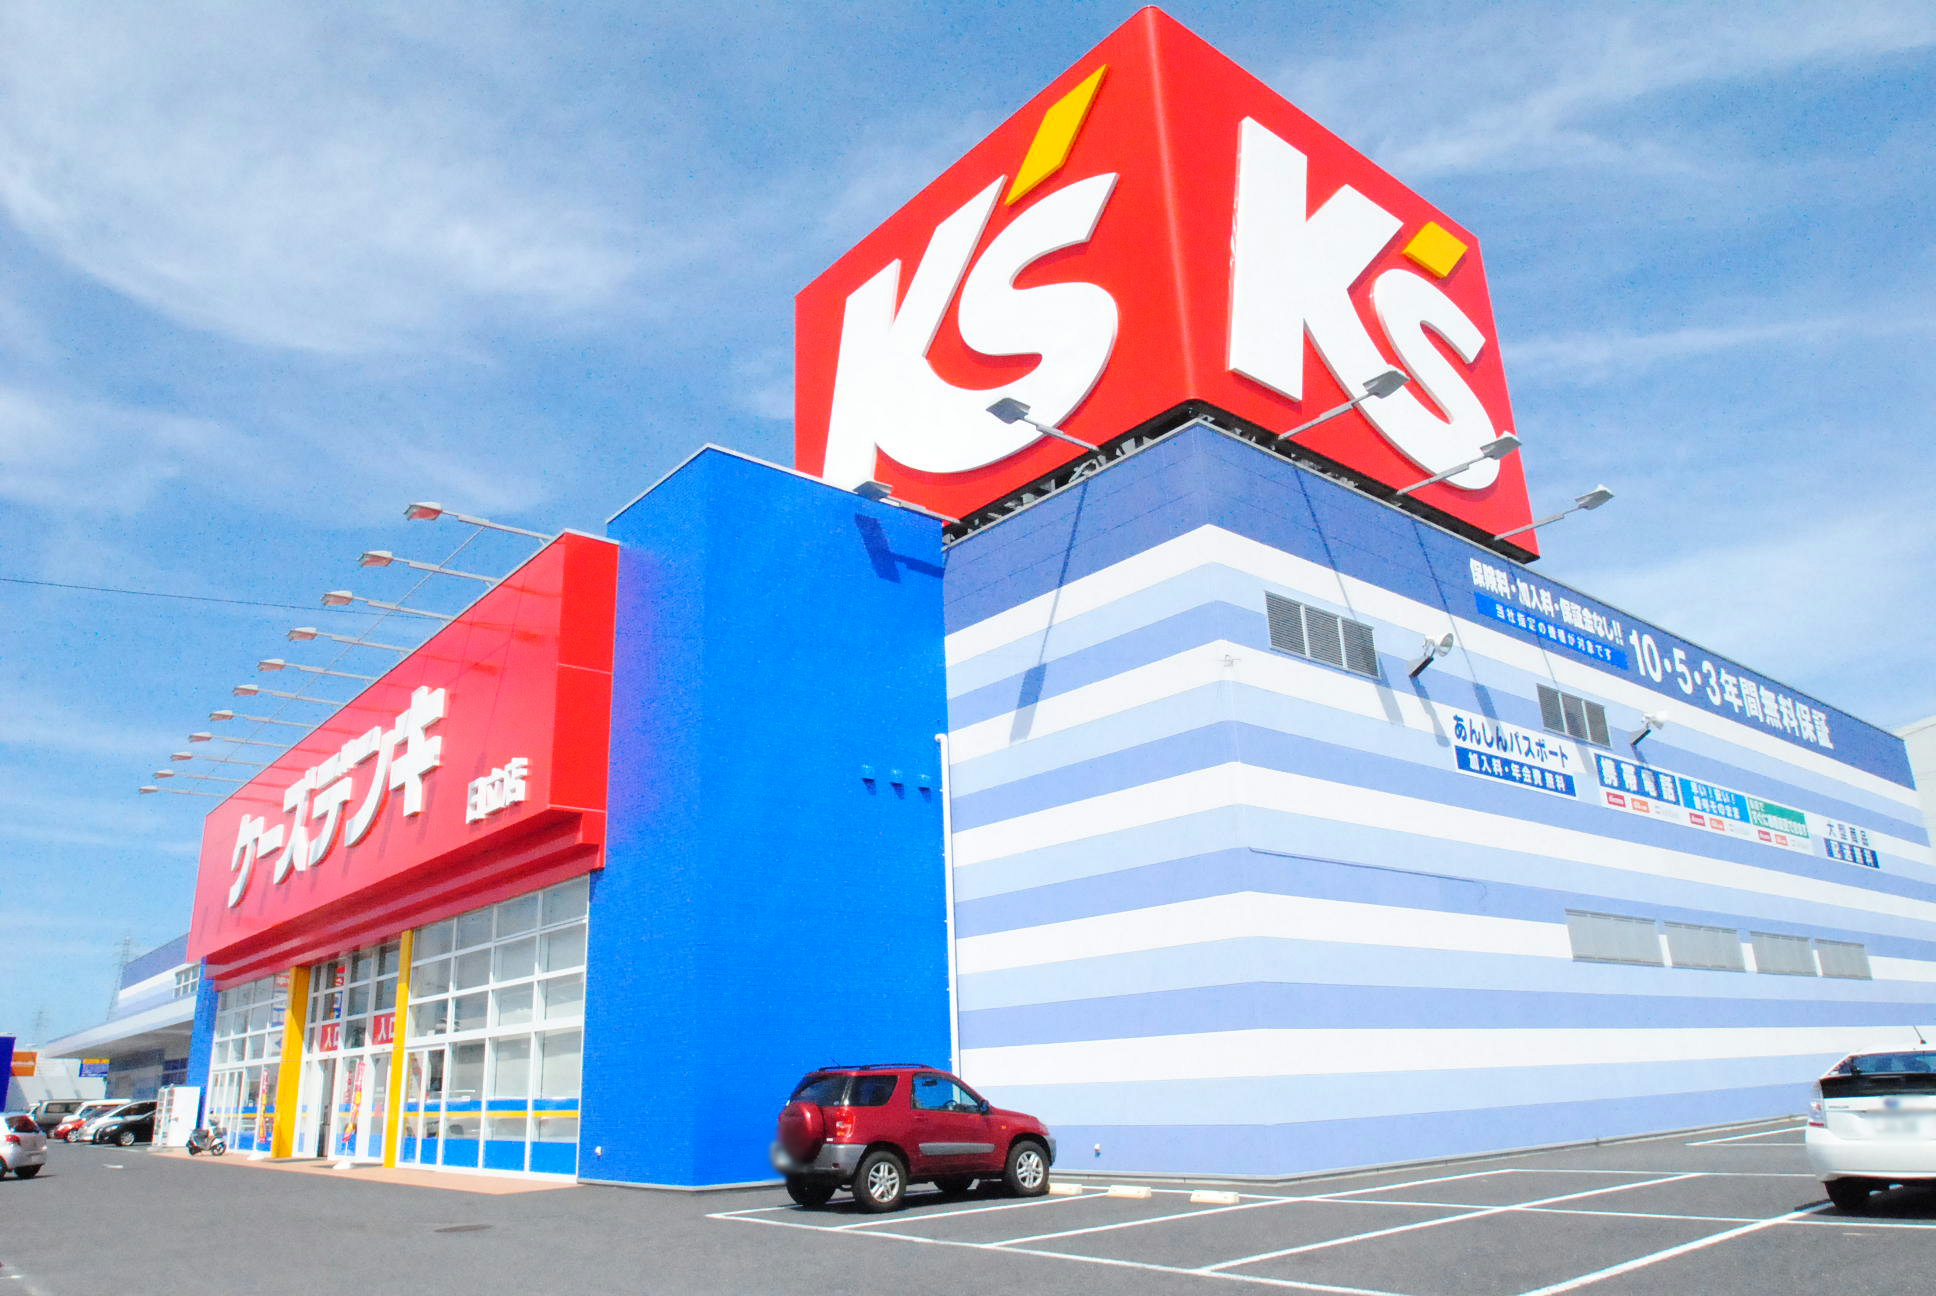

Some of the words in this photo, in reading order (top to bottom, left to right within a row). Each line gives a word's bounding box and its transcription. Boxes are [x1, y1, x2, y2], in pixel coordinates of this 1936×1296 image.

[227, 685, 447, 908] ケーズデンキ
[1453, 713, 1569, 769] あんしんパスポート
